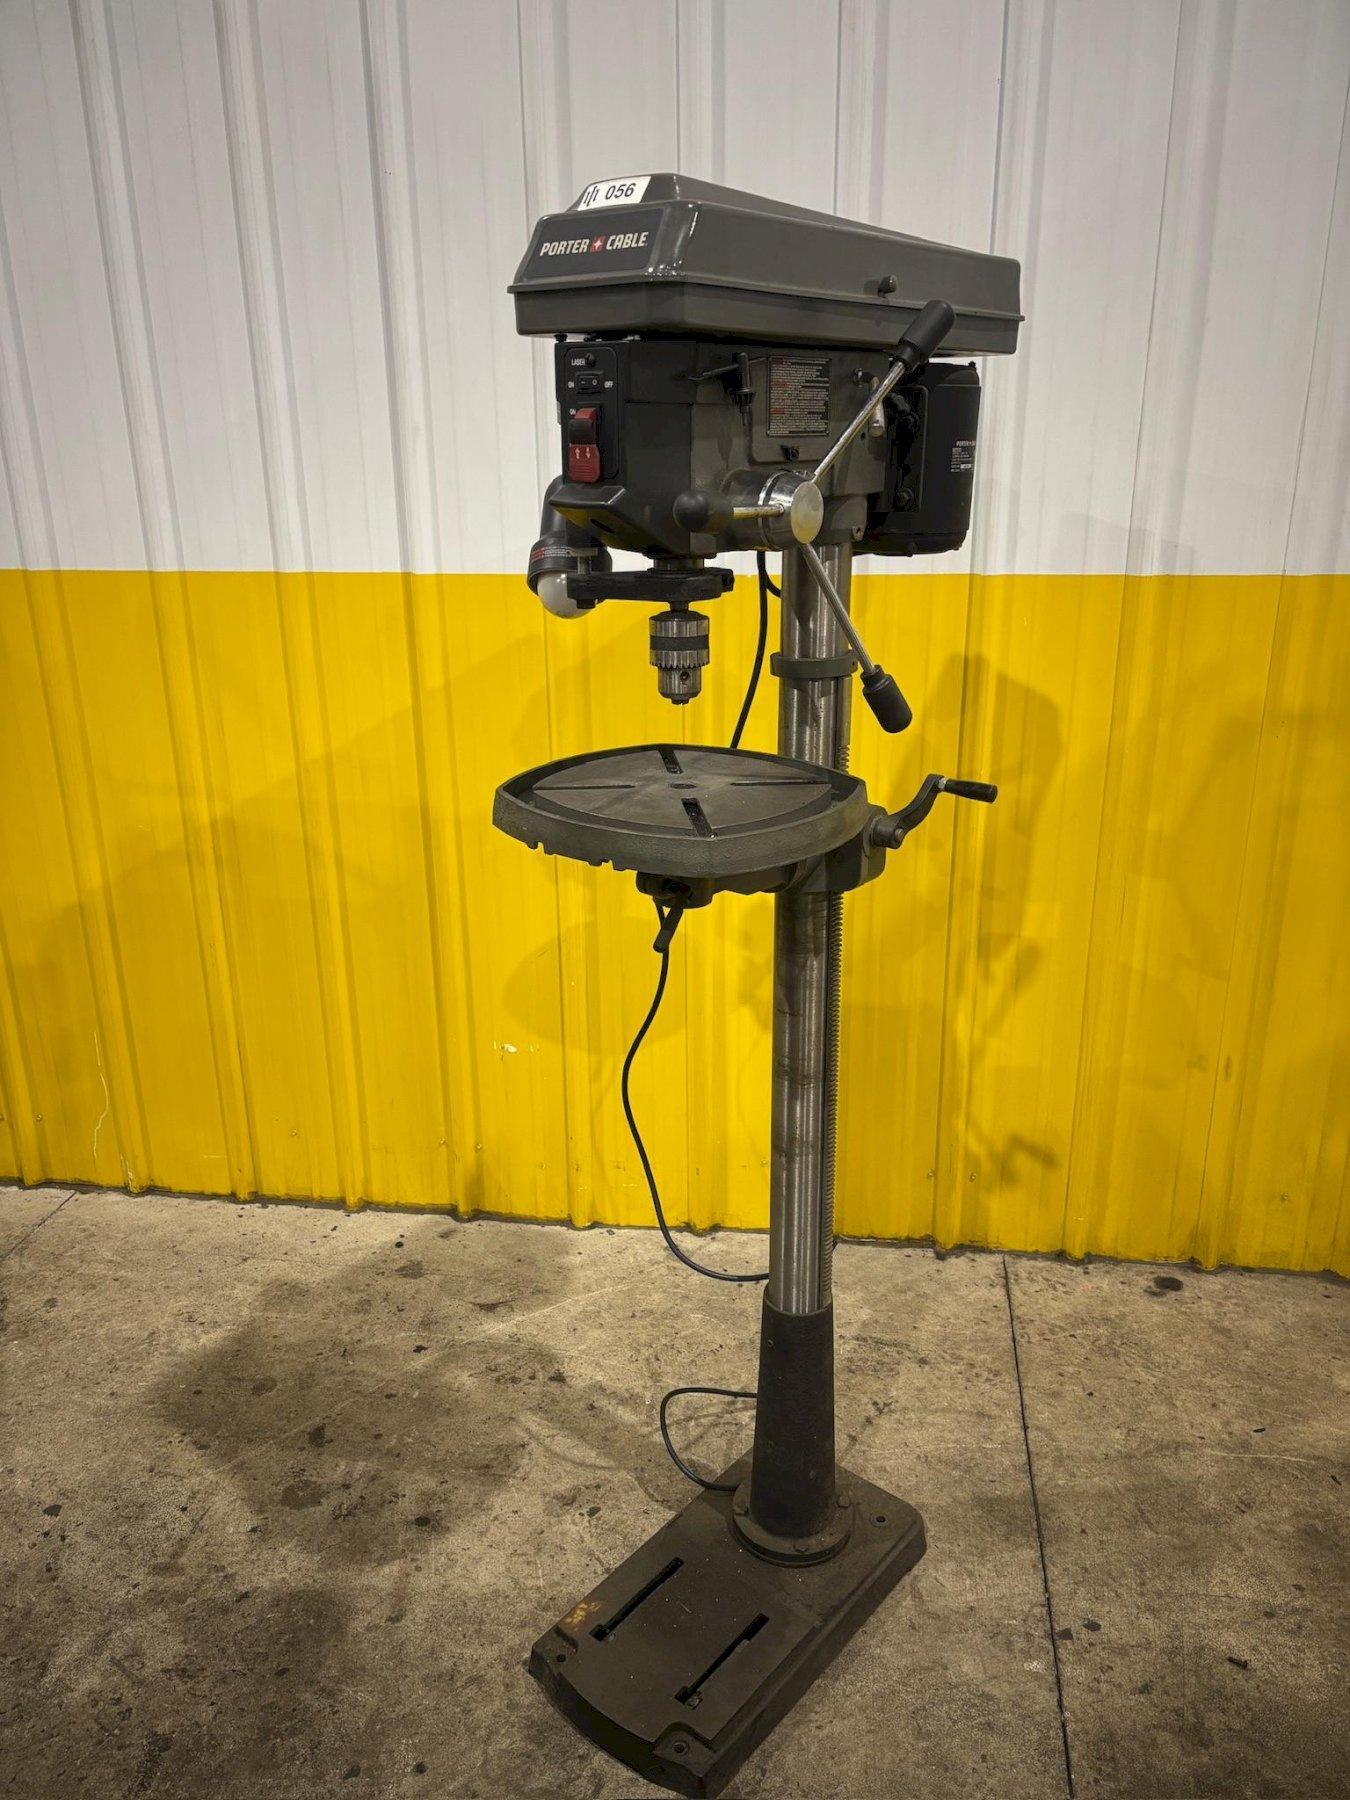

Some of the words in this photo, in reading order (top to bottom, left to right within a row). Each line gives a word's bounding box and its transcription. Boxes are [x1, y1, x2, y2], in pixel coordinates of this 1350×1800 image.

[605, 183, 636, 200] 056
[540, 239, 590, 256] PORTER
[606, 232, 649, 250] CABLE
[571, 358, 586, 366] LASER
